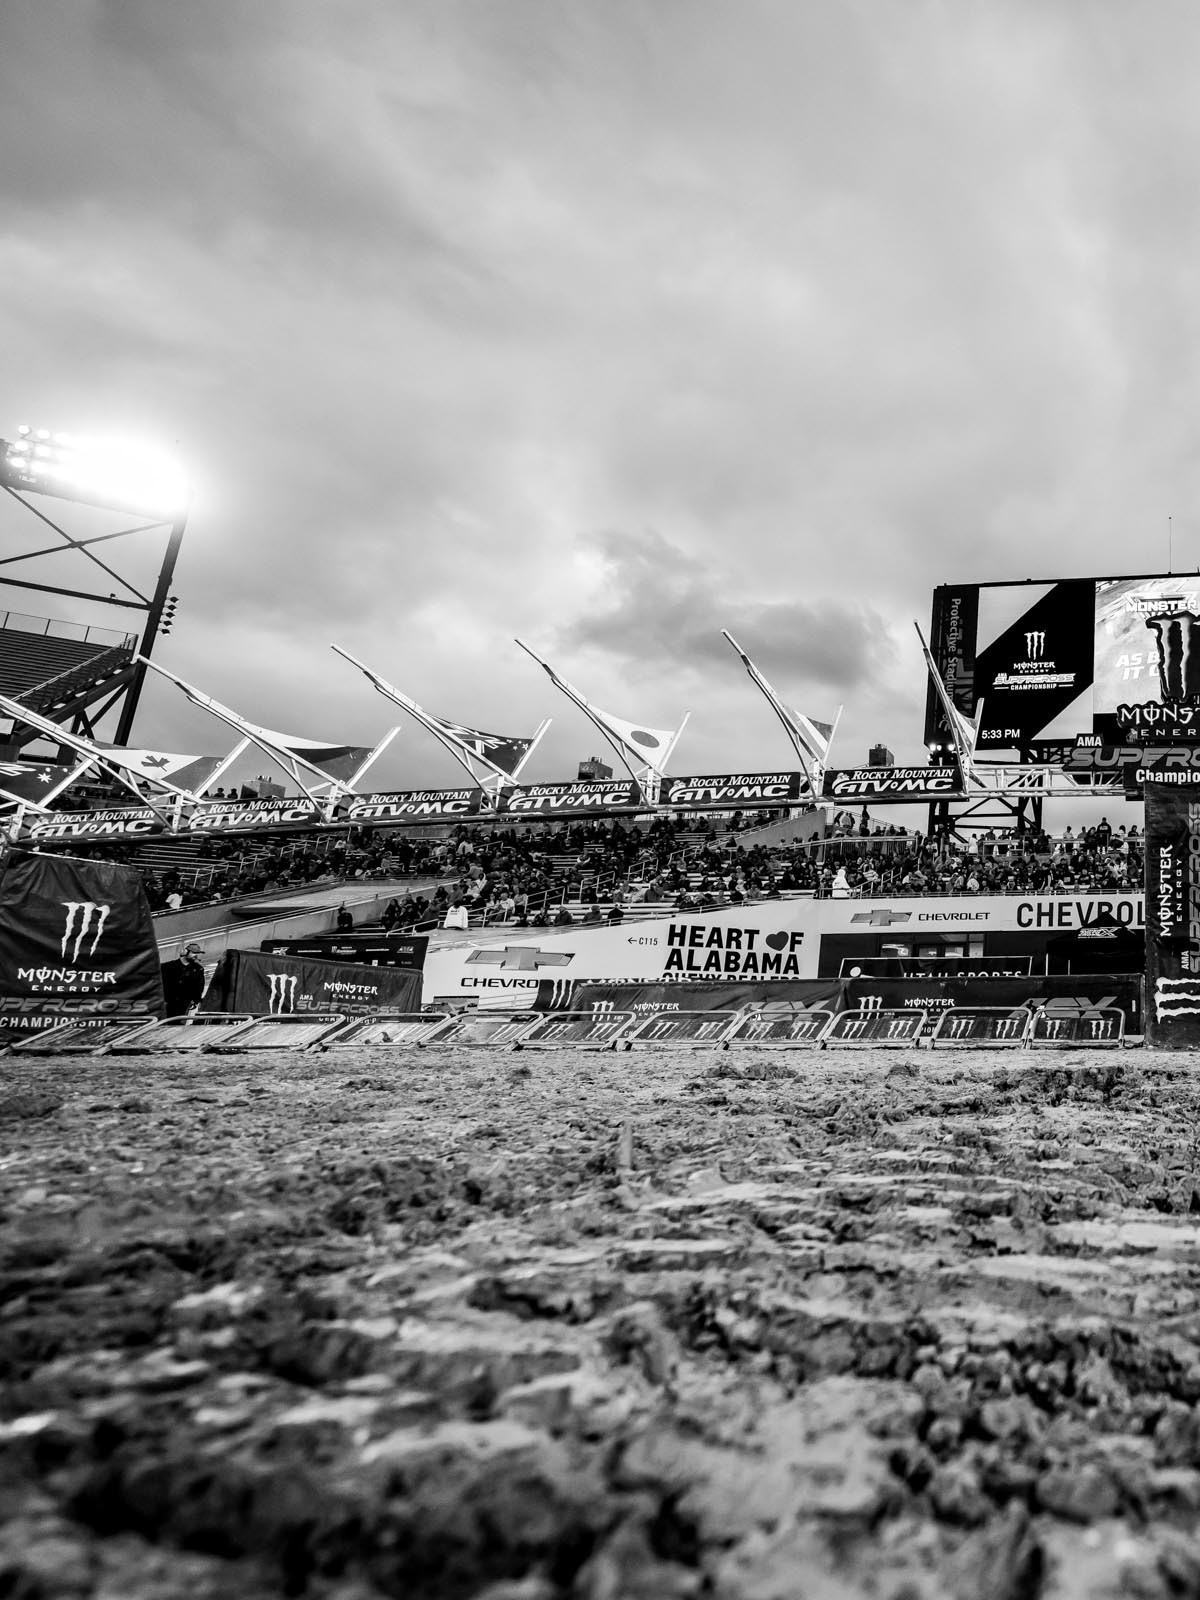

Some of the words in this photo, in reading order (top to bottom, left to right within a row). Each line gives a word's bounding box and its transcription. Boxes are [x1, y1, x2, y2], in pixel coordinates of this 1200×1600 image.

[948, 598, 962, 652] Protective
[1013, 662, 1056, 670] MONSTER
[1116, 653, 1143, 667] AS
[945, 656, 959, 701] Stadium
[992, 673, 1076, 685] SUPERCROSS
[1121, 665, 1144, 680] IT
[981, 730, 1003, 739] 5:33
[1004, 729, 1021, 739] PM
[1077, 736, 1103, 747] AMA
[851, 771, 891, 780] ROCKY
[891, 769, 954, 779] MOUNTAIN
[688, 777, 727, 788] ROCKY
[729, 775, 791, 786] MOUNTAIN
[528, 786, 568, 796] ROCKY
[569, 783, 633, 794] MOUNTAIN
[368, 794, 408, 804] ROCKY
[409, 791, 473, 802] MOUNTAIN
[208, 803, 246, 814] ROCKY
[247, 799, 313, 811] MOUNTAIN
[51, 812, 91, 824] ROCKY
[92, 810, 155, 820] MOUNTAIN
[1157, 844, 1174, 937] MONSTER
[918, 912, 990, 921] CHEVROLET
[1017, 901, 1146, 928] CHEVROL
[638, 937, 658, 946] C115
[667, 924, 760, 951] HEART
[664, 948, 800, 975] ALABAMA
[1181, 950, 1190, 970] AMA
[17, 966, 117, 984] MONSTER
[31, 984, 101, 992] ENERGY
[324, 982, 378, 995] MONSTER
[460, 977, 539, 989] CHEVRO
[0, 997, 150, 1013] PERCROSS
[296, 1000, 400, 1014] SUPERCROSS
[633, 1002, 680, 1012] MONSTER
[904, 997, 955, 1007] MONSTER
